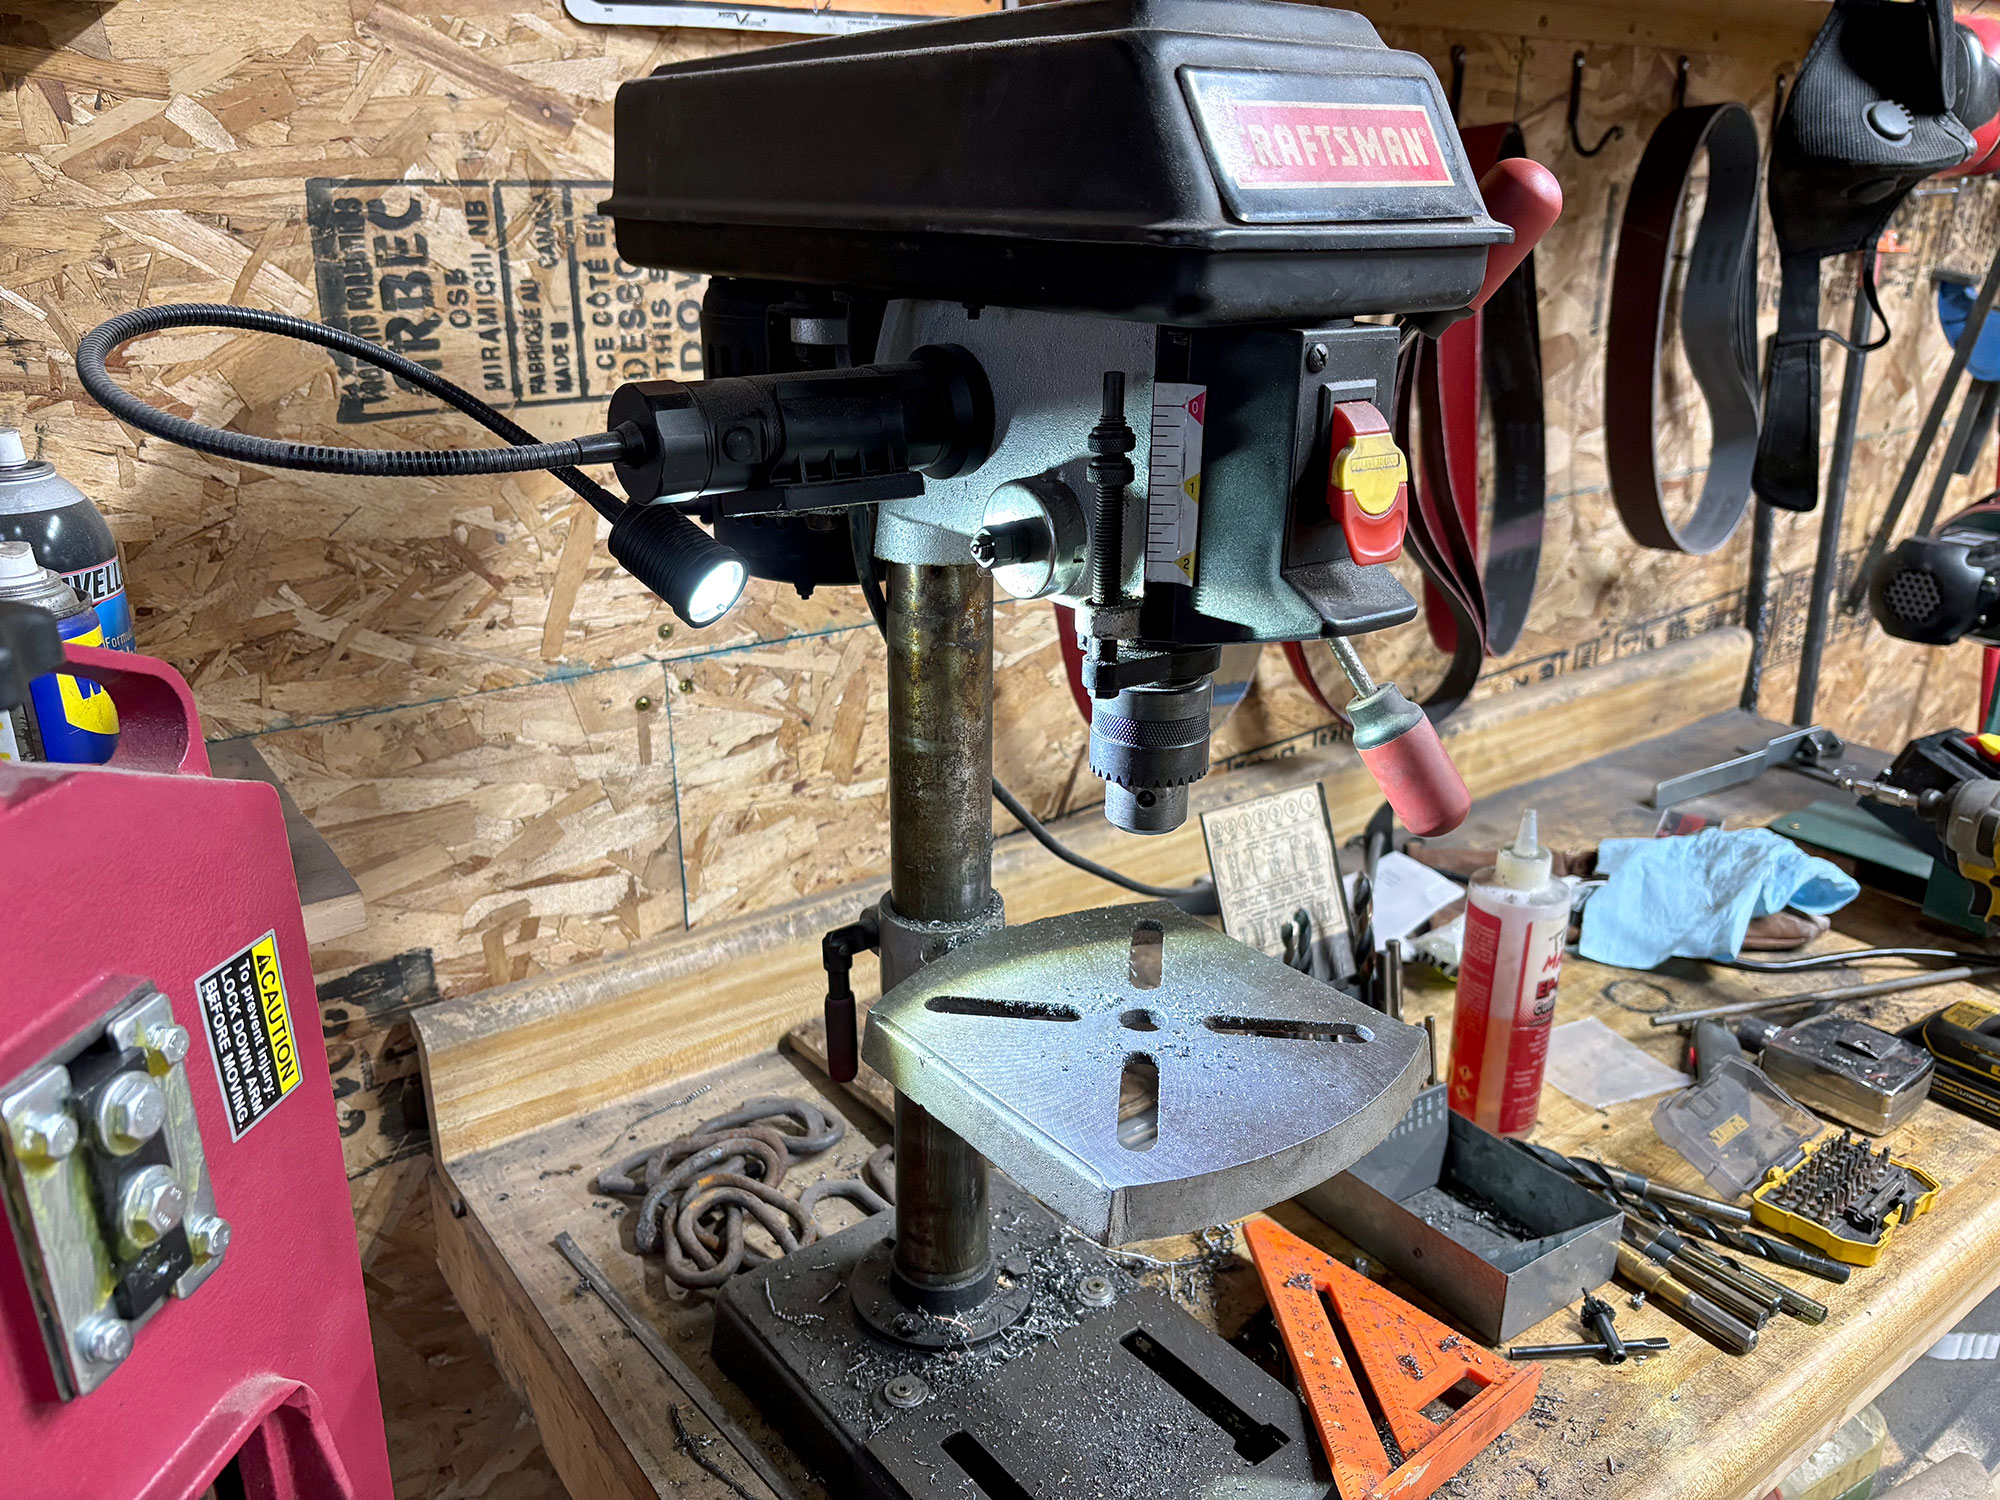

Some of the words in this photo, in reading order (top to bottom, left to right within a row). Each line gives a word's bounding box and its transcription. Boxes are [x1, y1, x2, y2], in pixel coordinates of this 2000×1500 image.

[466, 200, 490, 236] NB
[445, 268, 472, 329] OSB
[520, 279, 540, 303] AU
[583, 258, 614, 327] CÔTÉ
[594, 337, 616, 371] CE
[651, 298, 675, 374] THIS
[552, 343, 574, 393] MADE
[1191, 400, 1199, 415] 0
[1189, 481, 1196, 494] 1
[1183, 556, 1190, 570] 2
[239, 958, 250, 982] To
[220, 967, 242, 1021] LOCK
[232, 1018, 255, 1077] DOWN
[246, 1077, 265, 1116] ARM
[241, 984, 265, 1048] prevent
[261, 974, 295, 1083] CAUTION
[204, 977, 232, 1054] BEFORE
[222, 1051, 249, 1129] MOVING.
[257, 1045, 276, 1099] injury:
